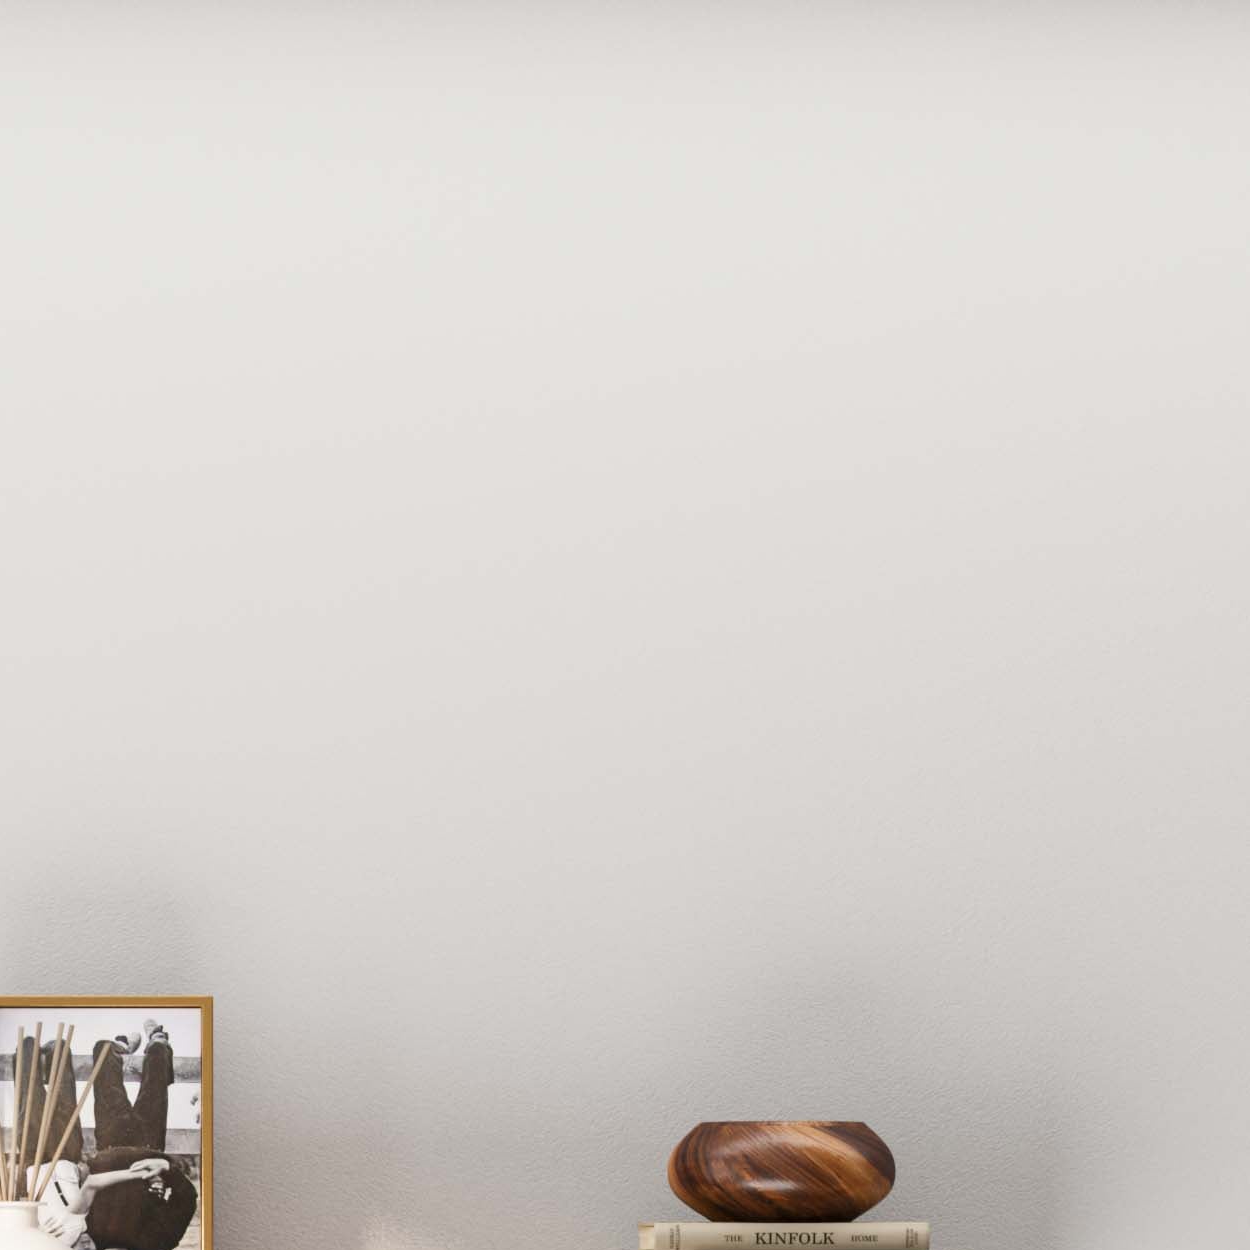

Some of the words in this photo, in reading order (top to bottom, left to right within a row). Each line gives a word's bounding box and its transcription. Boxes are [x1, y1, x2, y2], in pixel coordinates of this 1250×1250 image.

[723, 1234, 743, 1243] THE
[755, 1232, 835, 1245] KINFOLK
[851, 1234, 879, 1243] HOME
